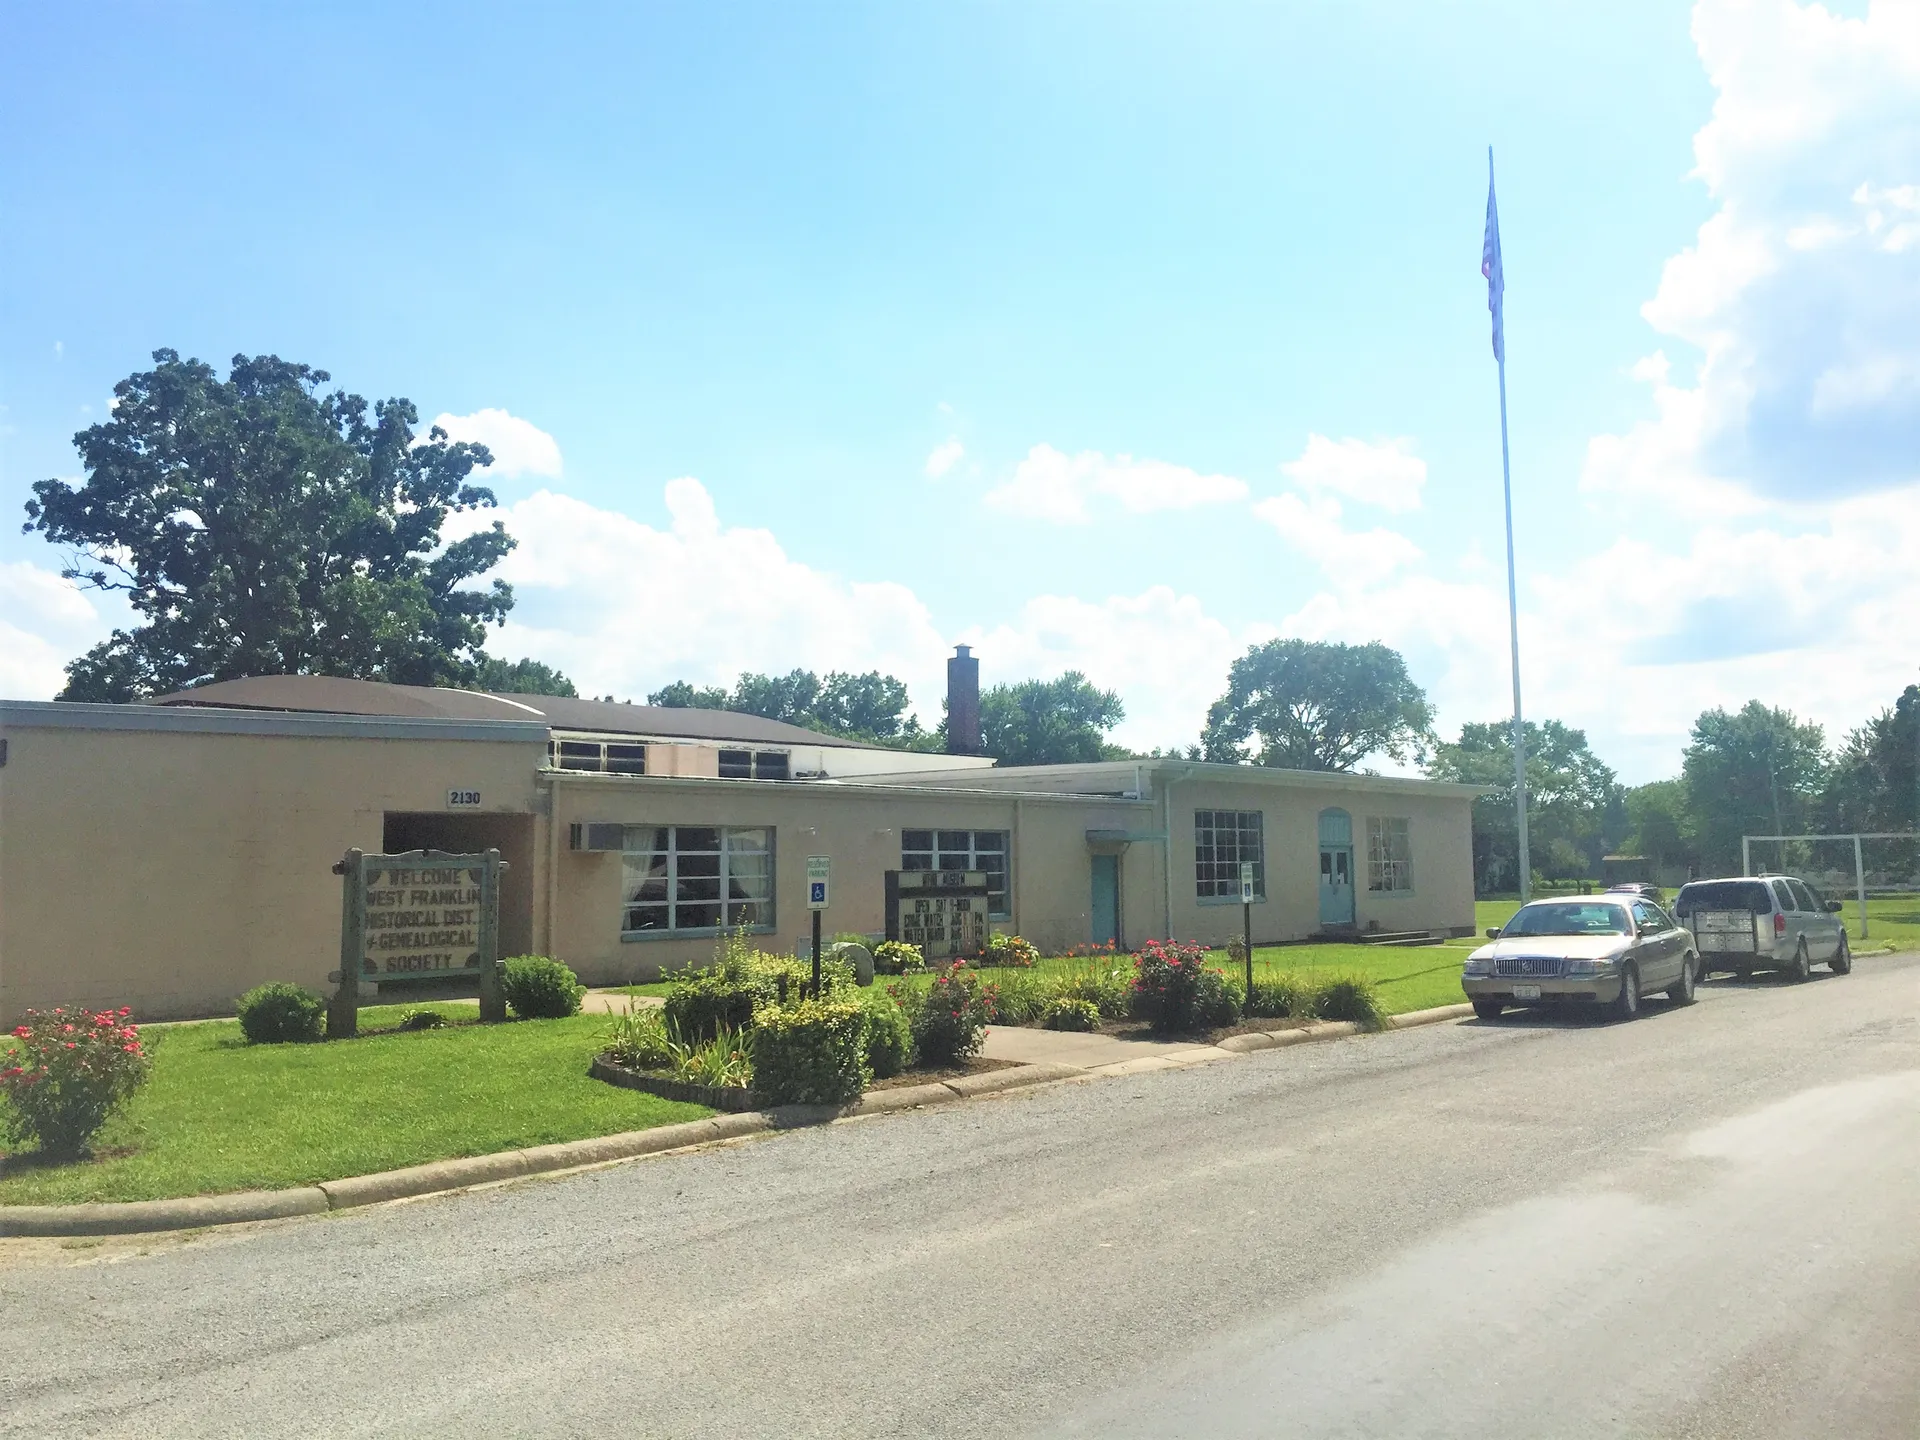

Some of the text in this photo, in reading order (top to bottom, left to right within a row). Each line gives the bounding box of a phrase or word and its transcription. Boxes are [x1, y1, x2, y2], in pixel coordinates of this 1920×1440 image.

[450, 791, 480, 804] 2130
[389, 869, 462, 885] WELCOME
[366, 889, 481, 906] WEST FRANKLIN
[915, 899, 930, 913] OPEN
[935, 899, 947, 913] SAT
[365, 909, 478, 929] HISTORICAL DIST.
[380, 930, 475, 950] GENEALOGICAL
[386, 954, 453, 972] SOCIETY
